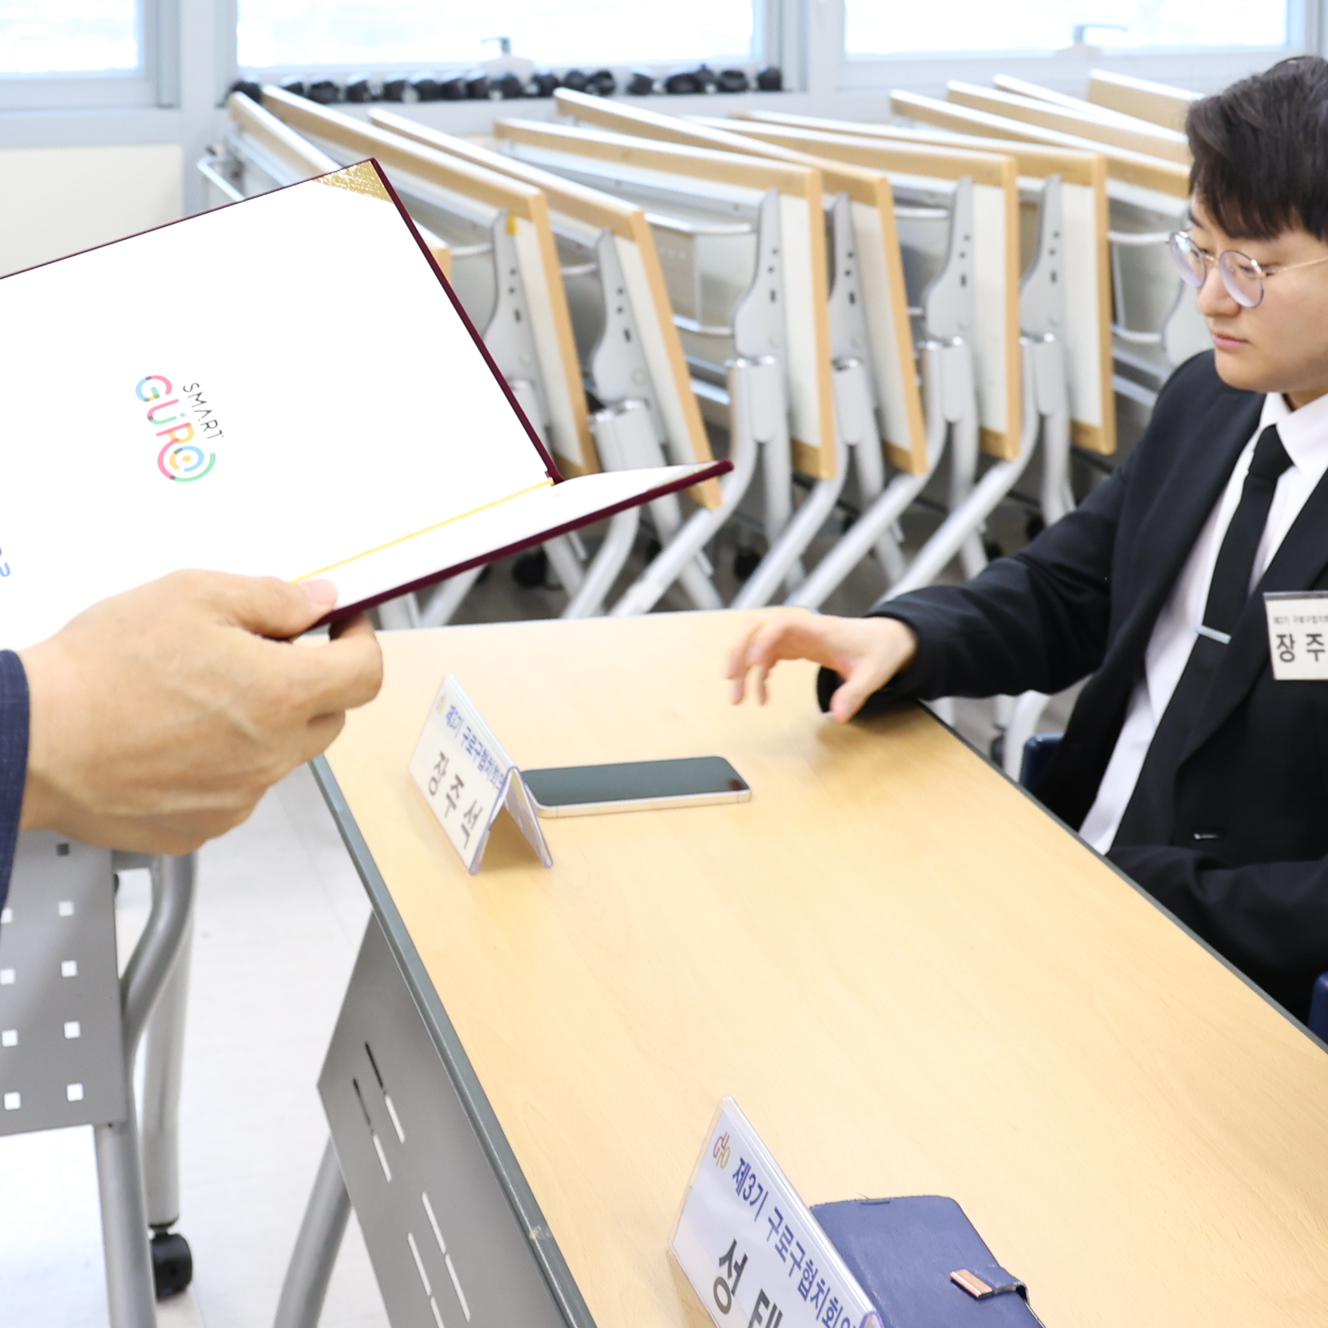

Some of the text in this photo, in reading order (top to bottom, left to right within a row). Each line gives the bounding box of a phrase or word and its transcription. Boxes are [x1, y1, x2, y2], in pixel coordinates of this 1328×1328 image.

[135, 374, 216, 483] GURO
[182, 382, 225, 441] SMART
[732, 1157, 769, 1222] 제3기
